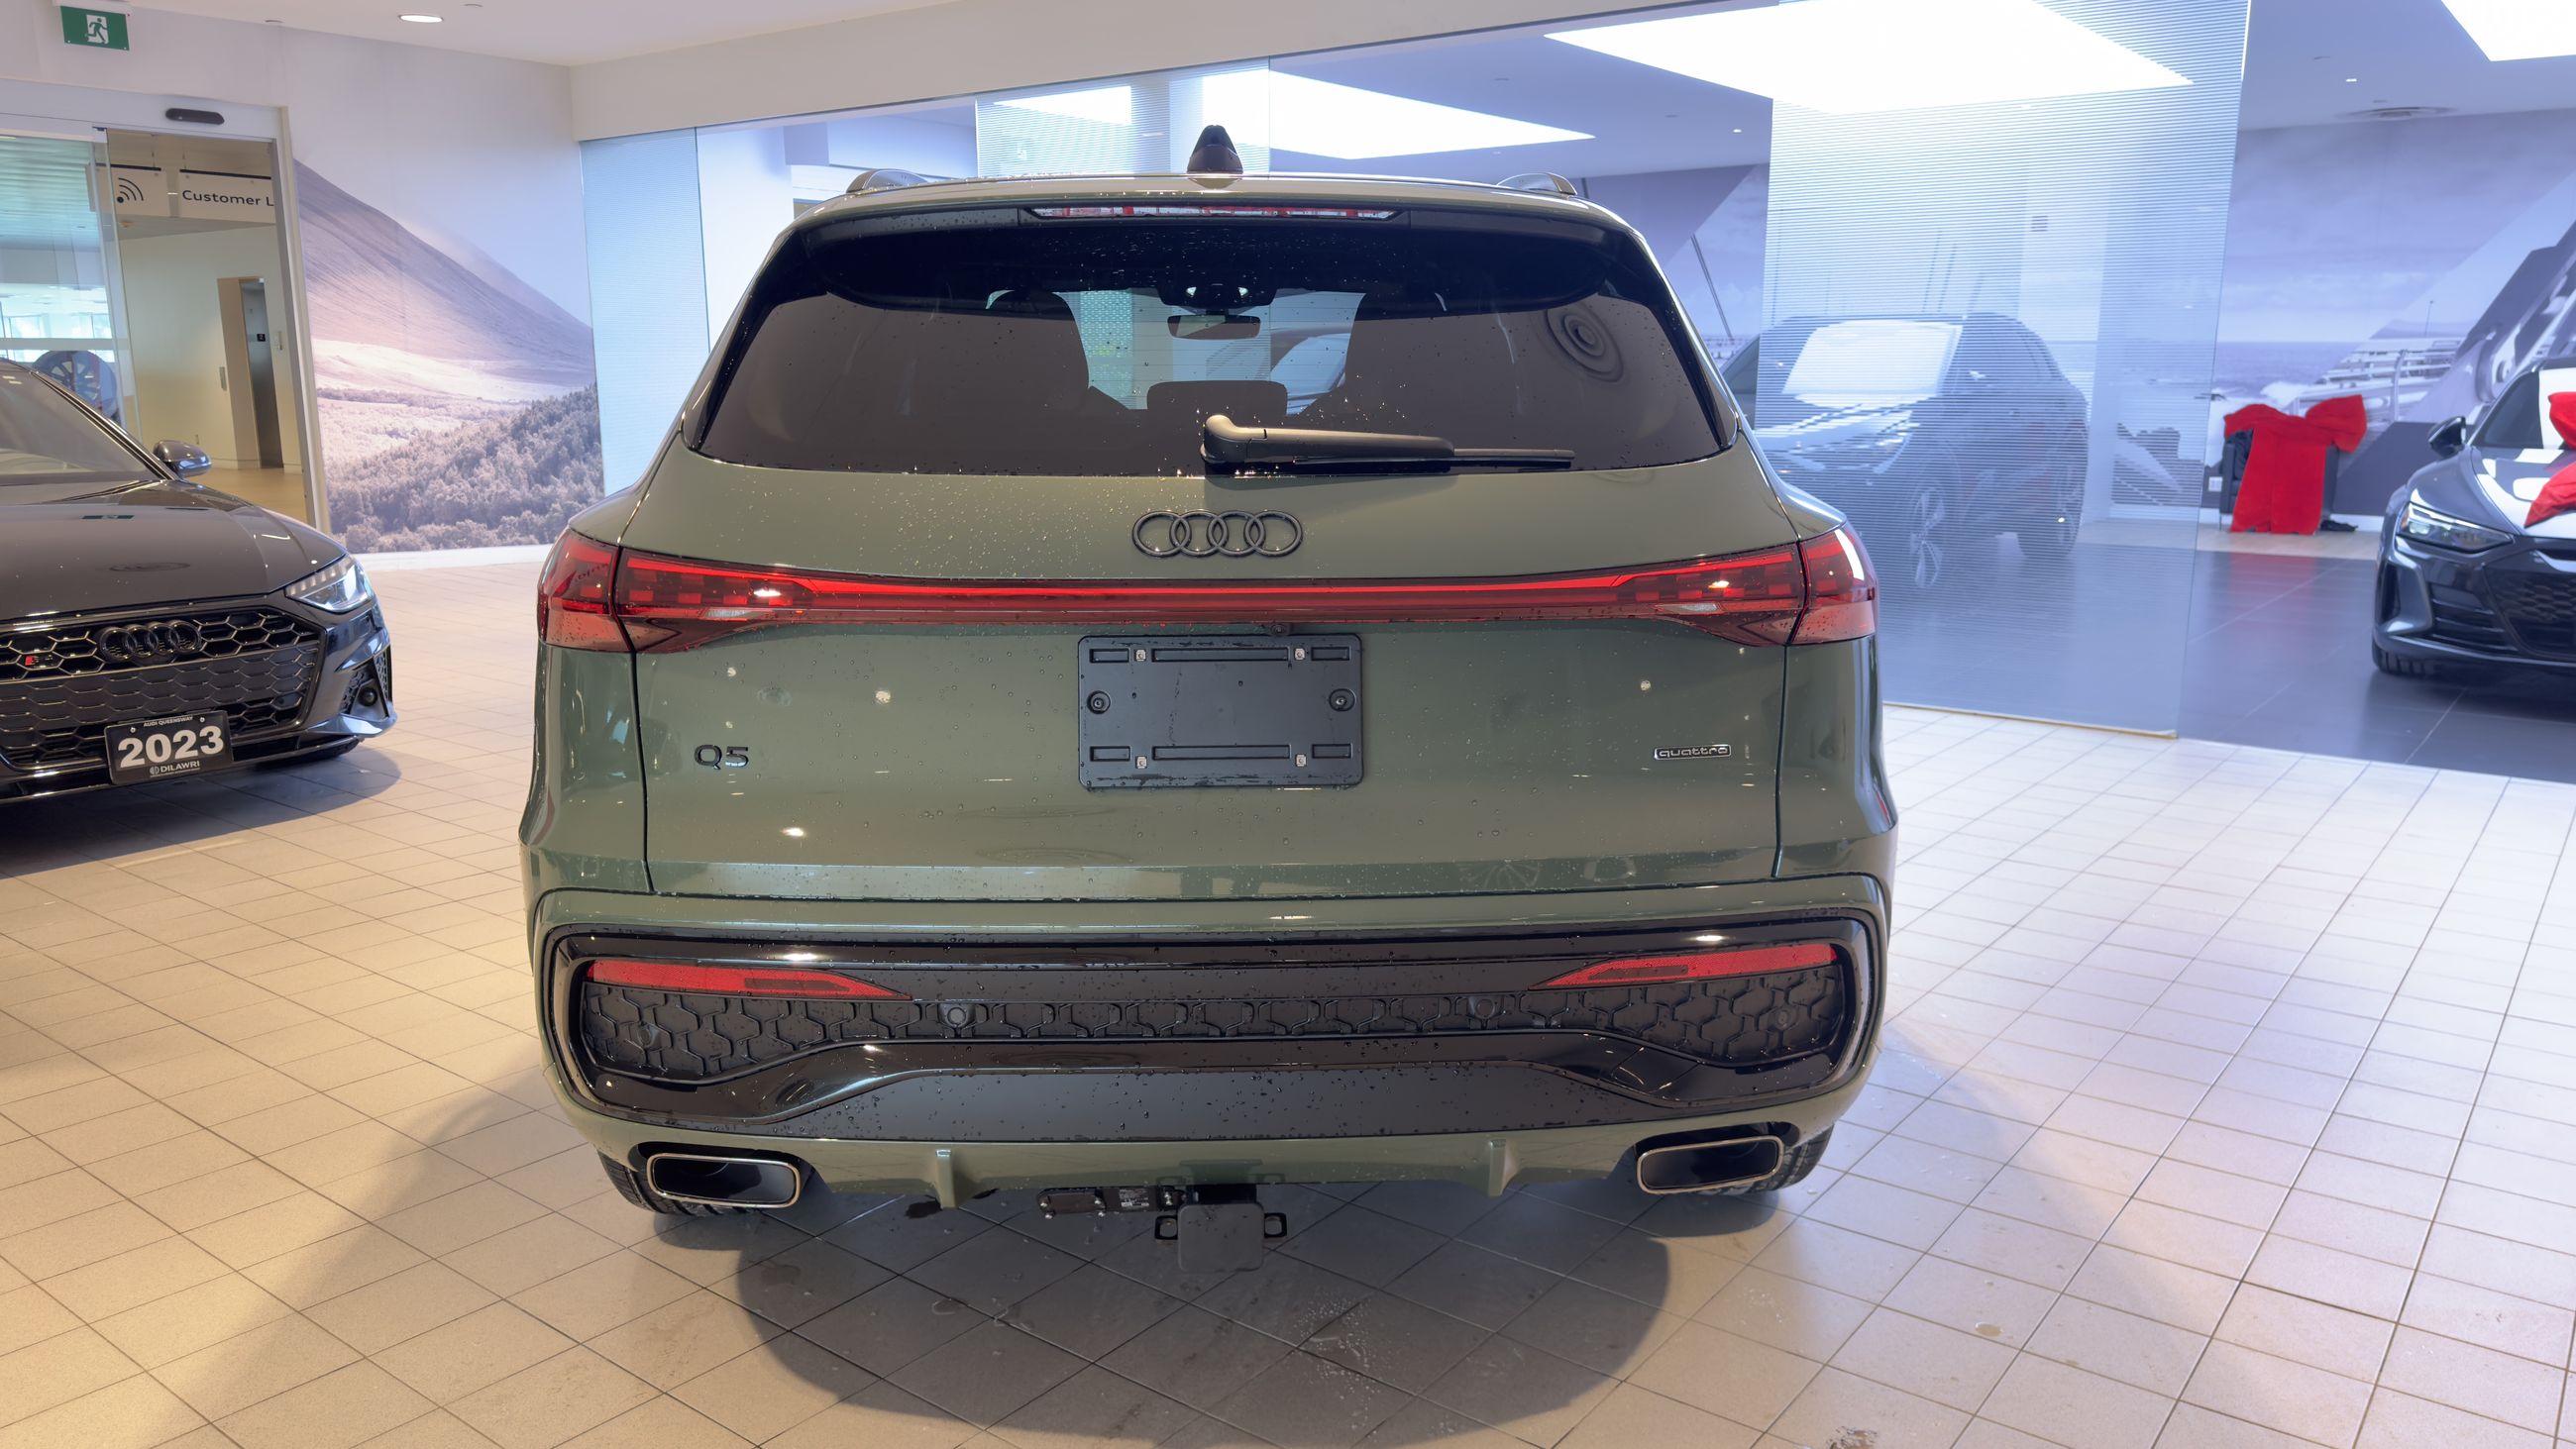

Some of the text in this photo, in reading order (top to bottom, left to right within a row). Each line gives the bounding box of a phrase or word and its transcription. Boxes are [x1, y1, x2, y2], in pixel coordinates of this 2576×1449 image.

[182, 189, 261, 206] Customer
[158, 716, 193, 726] QUEENSWAY
[118, 725, 224, 769] 2023
[1659, 747, 1728, 759] quattro
[695, 744, 749, 770] Q5
[160, 760, 200, 774] DILAWRI
